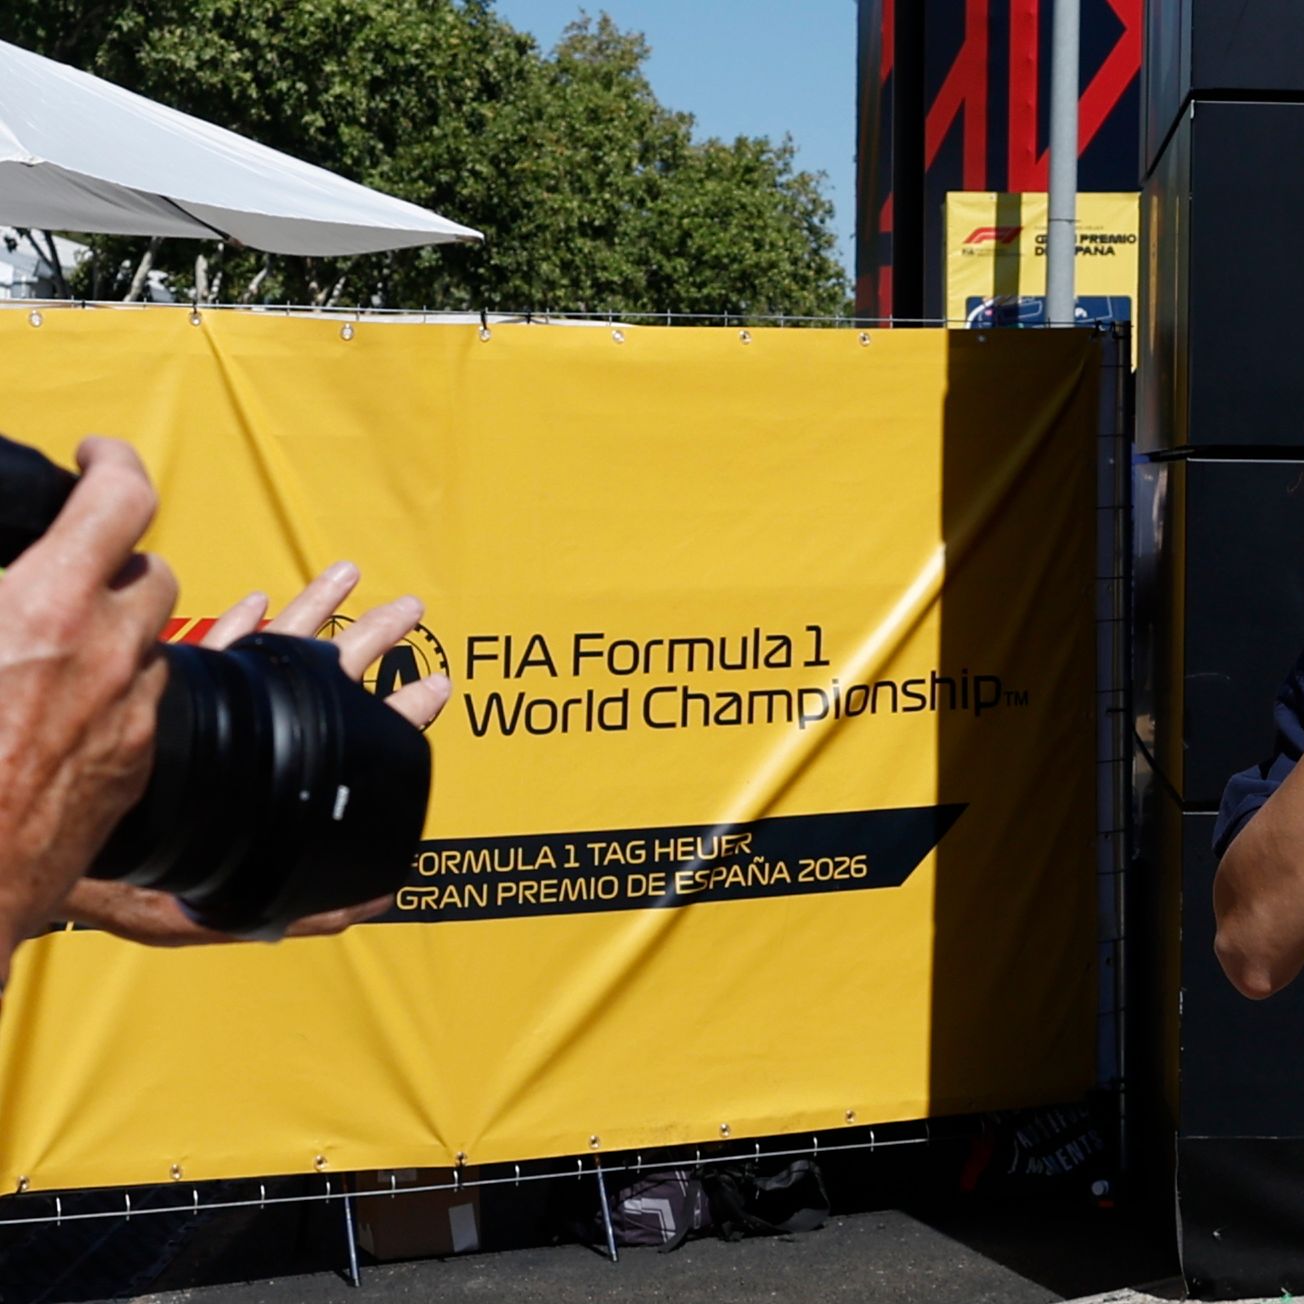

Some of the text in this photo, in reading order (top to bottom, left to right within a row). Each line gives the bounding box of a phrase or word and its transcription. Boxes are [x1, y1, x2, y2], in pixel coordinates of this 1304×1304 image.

[1080, 233, 1137, 244] PREMIO
[466, 625, 830, 679] FIA Formula 1
[464, 688, 629, 737] World
[643, 669, 1001, 729] Championship
[411, 833, 752, 876] ORMULA 1 TAG HEUER
[396, 855, 868, 910] GRAN PREMIO DE ESPAÑA 2026
